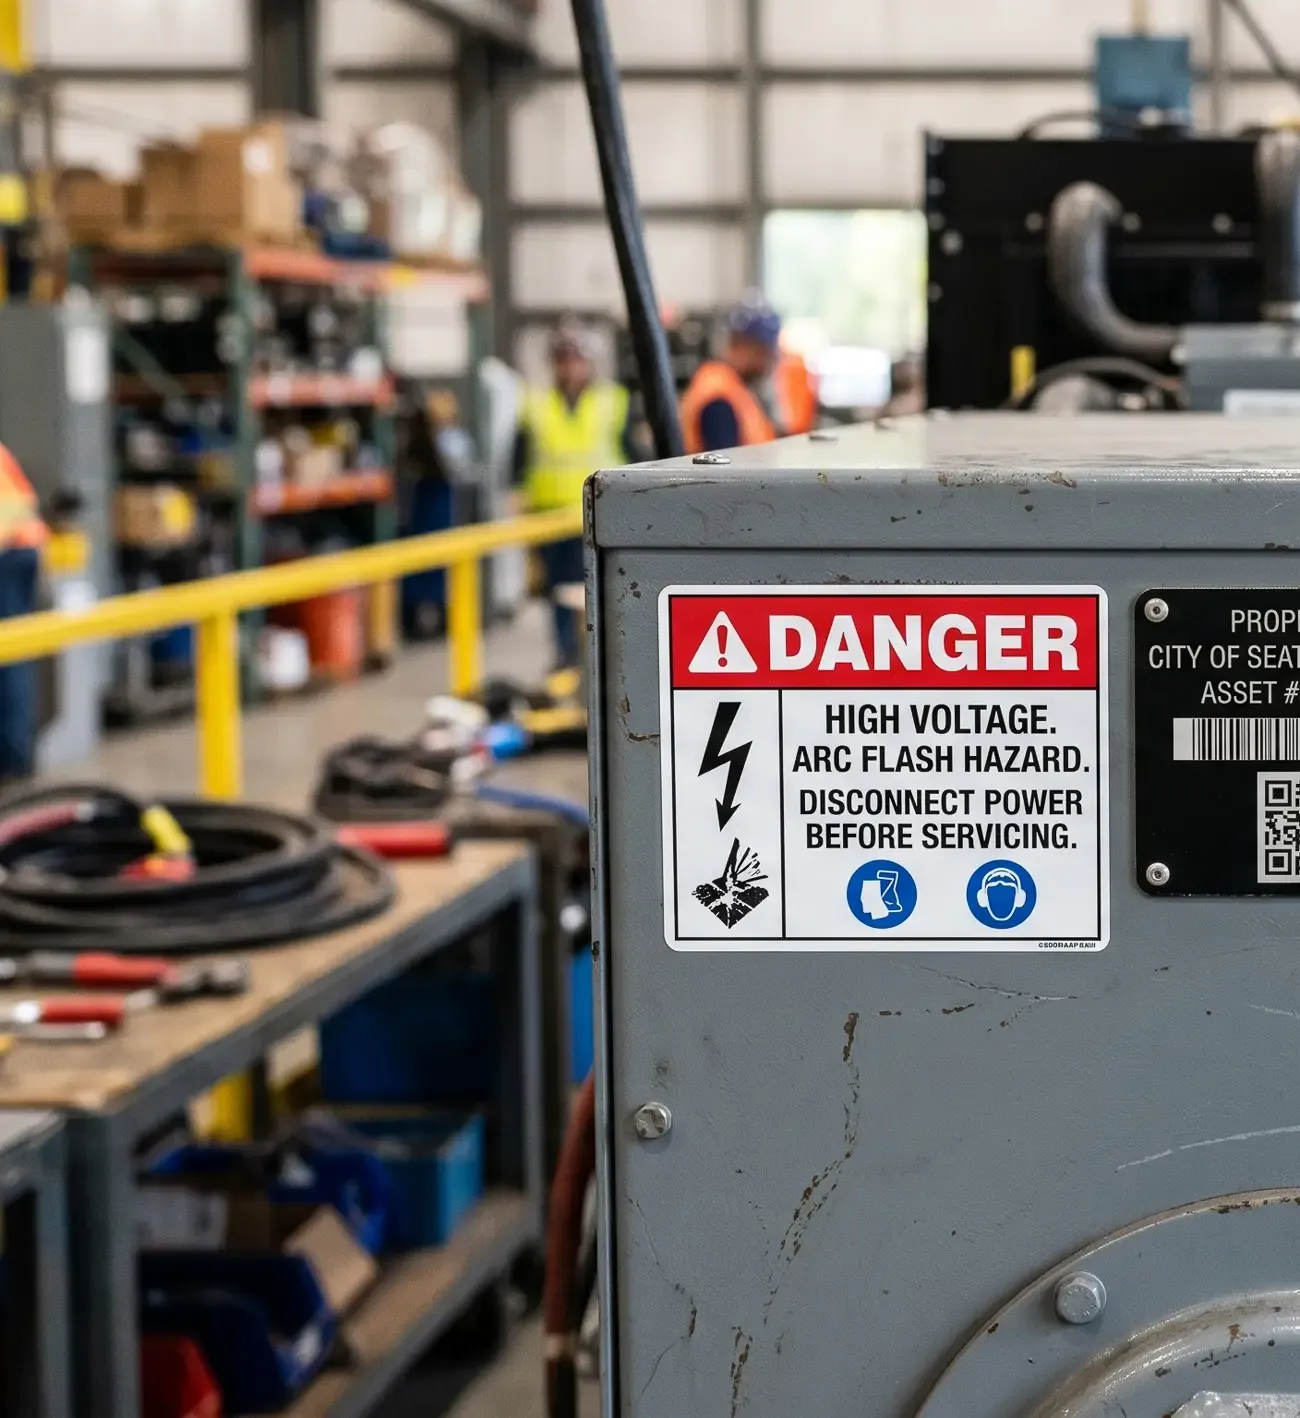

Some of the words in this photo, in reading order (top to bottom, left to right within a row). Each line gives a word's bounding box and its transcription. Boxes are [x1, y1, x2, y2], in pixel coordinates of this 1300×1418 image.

[769, 614, 1079, 671] DANGER
[1149, 645, 1202, 668] CITY
[1210, 645, 1239, 668] OF
[1201, 681, 1277, 704] ASSET
[826, 704, 899, 734] HIGH
[910, 704, 1056, 734] VOLTAGE.
[793, 745, 851, 772] ARC
[862, 746, 953, 772] FLASH
[965, 746, 1089, 772] HAZARD.
[800, 789, 975, 815] DISCONNECT
[985, 789, 1082, 815] POWER
[807, 823, 912, 849] BEFORE
[922, 823, 1076, 849] SERVICING.
